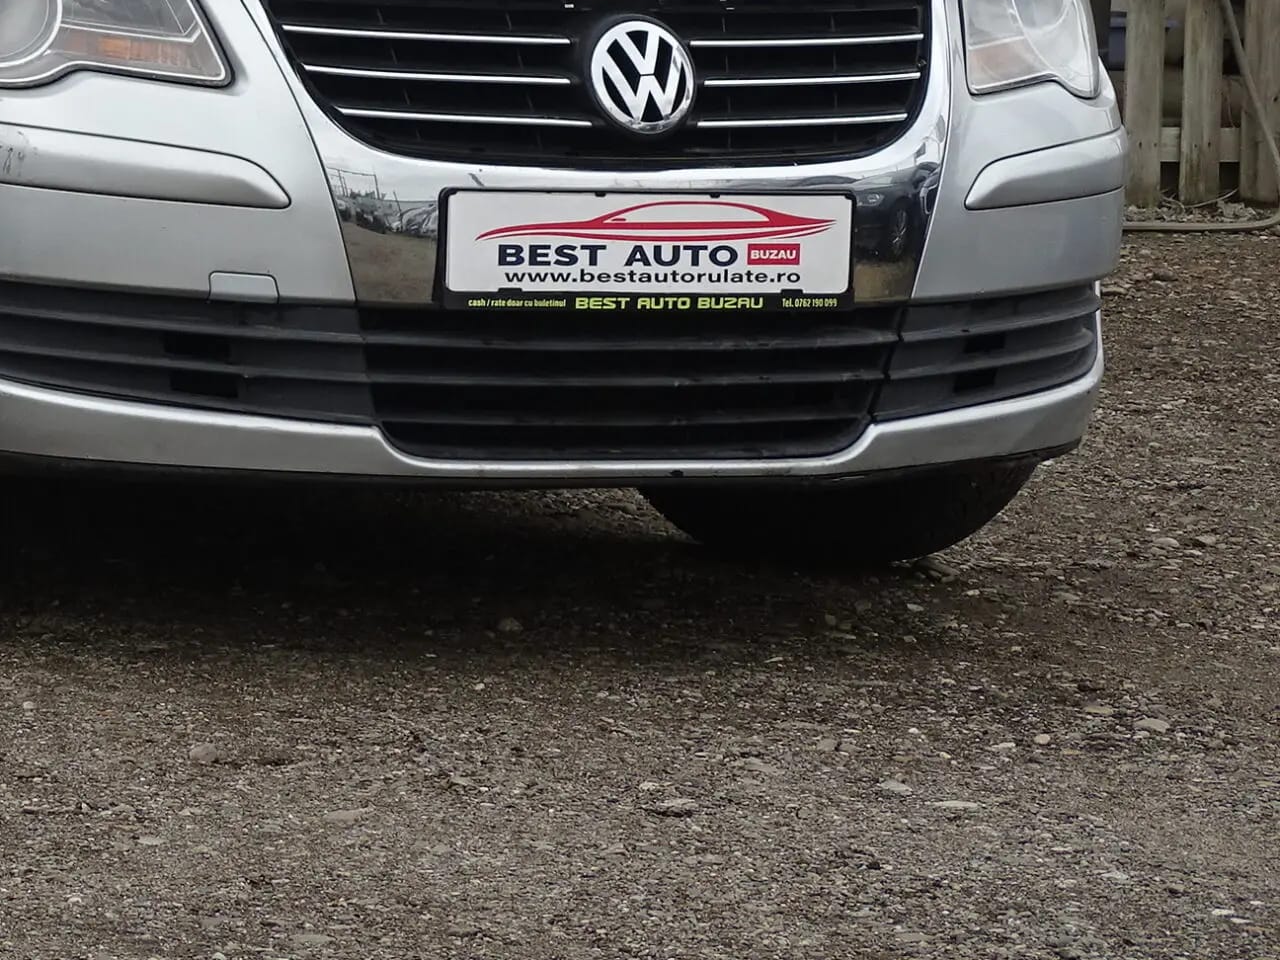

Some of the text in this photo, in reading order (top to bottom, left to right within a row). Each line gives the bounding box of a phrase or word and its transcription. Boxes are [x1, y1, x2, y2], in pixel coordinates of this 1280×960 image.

[498, 244, 796, 266] BEST AUTO BUZAU
[505, 269, 801, 283] www.bestautorulate.ro
[575, 297, 631, 309] BEST
[637, 297, 691, 309] AUTO
[697, 297, 764, 309] BUZAU
